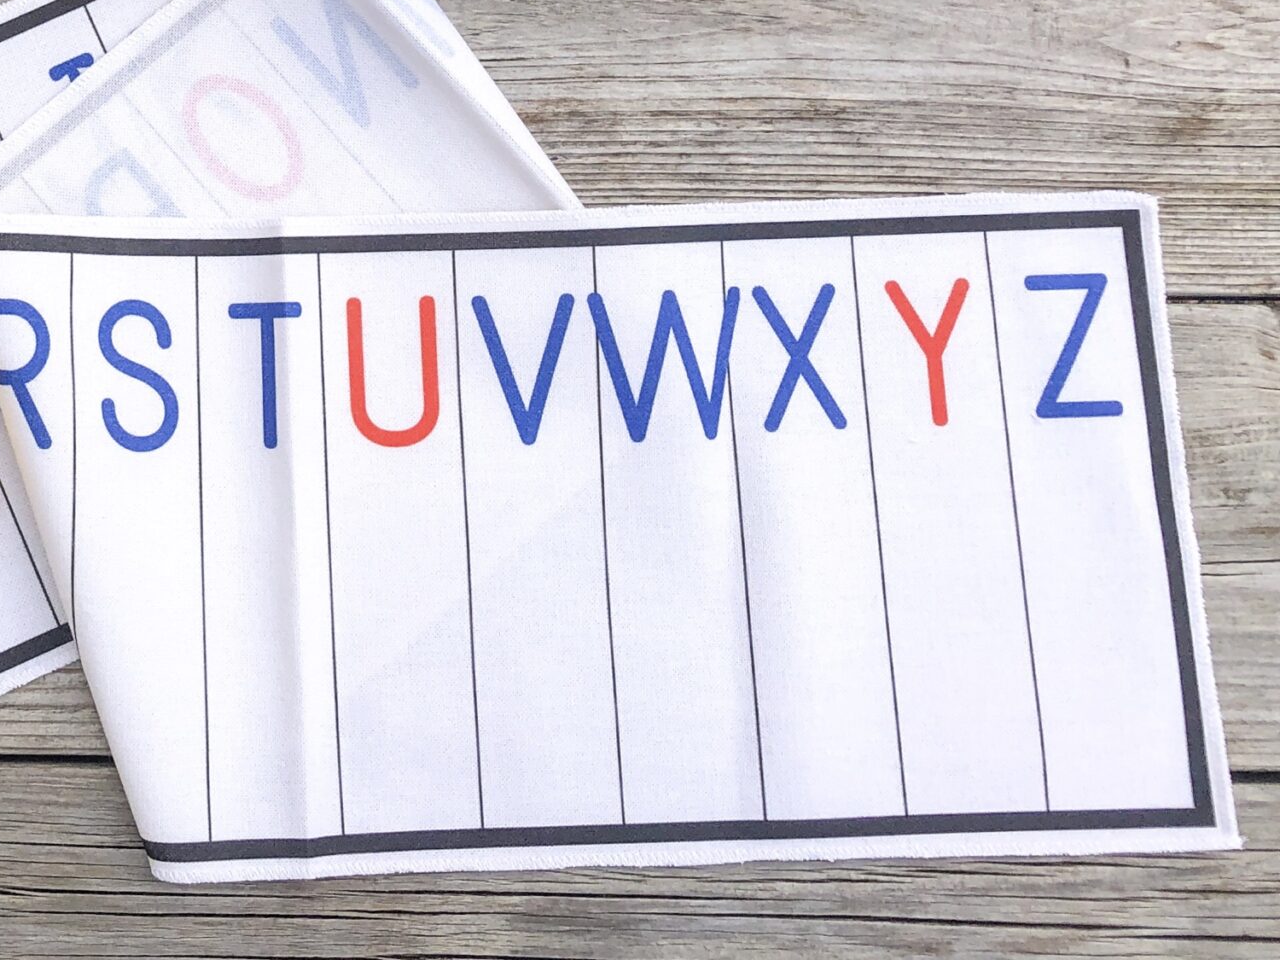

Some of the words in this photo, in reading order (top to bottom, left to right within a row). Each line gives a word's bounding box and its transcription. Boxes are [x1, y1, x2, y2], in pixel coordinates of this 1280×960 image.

[98, 299, 179, 452] S
[228, 301, 302, 449] T
[346, 296, 440, 448] U
[472, 293, 575, 445] V
[587, 286, 741, 443] W
[752, 283, 848, 433] X
[884, 277, 970, 427] Y
[1024, 273, 1123, 420] Z
